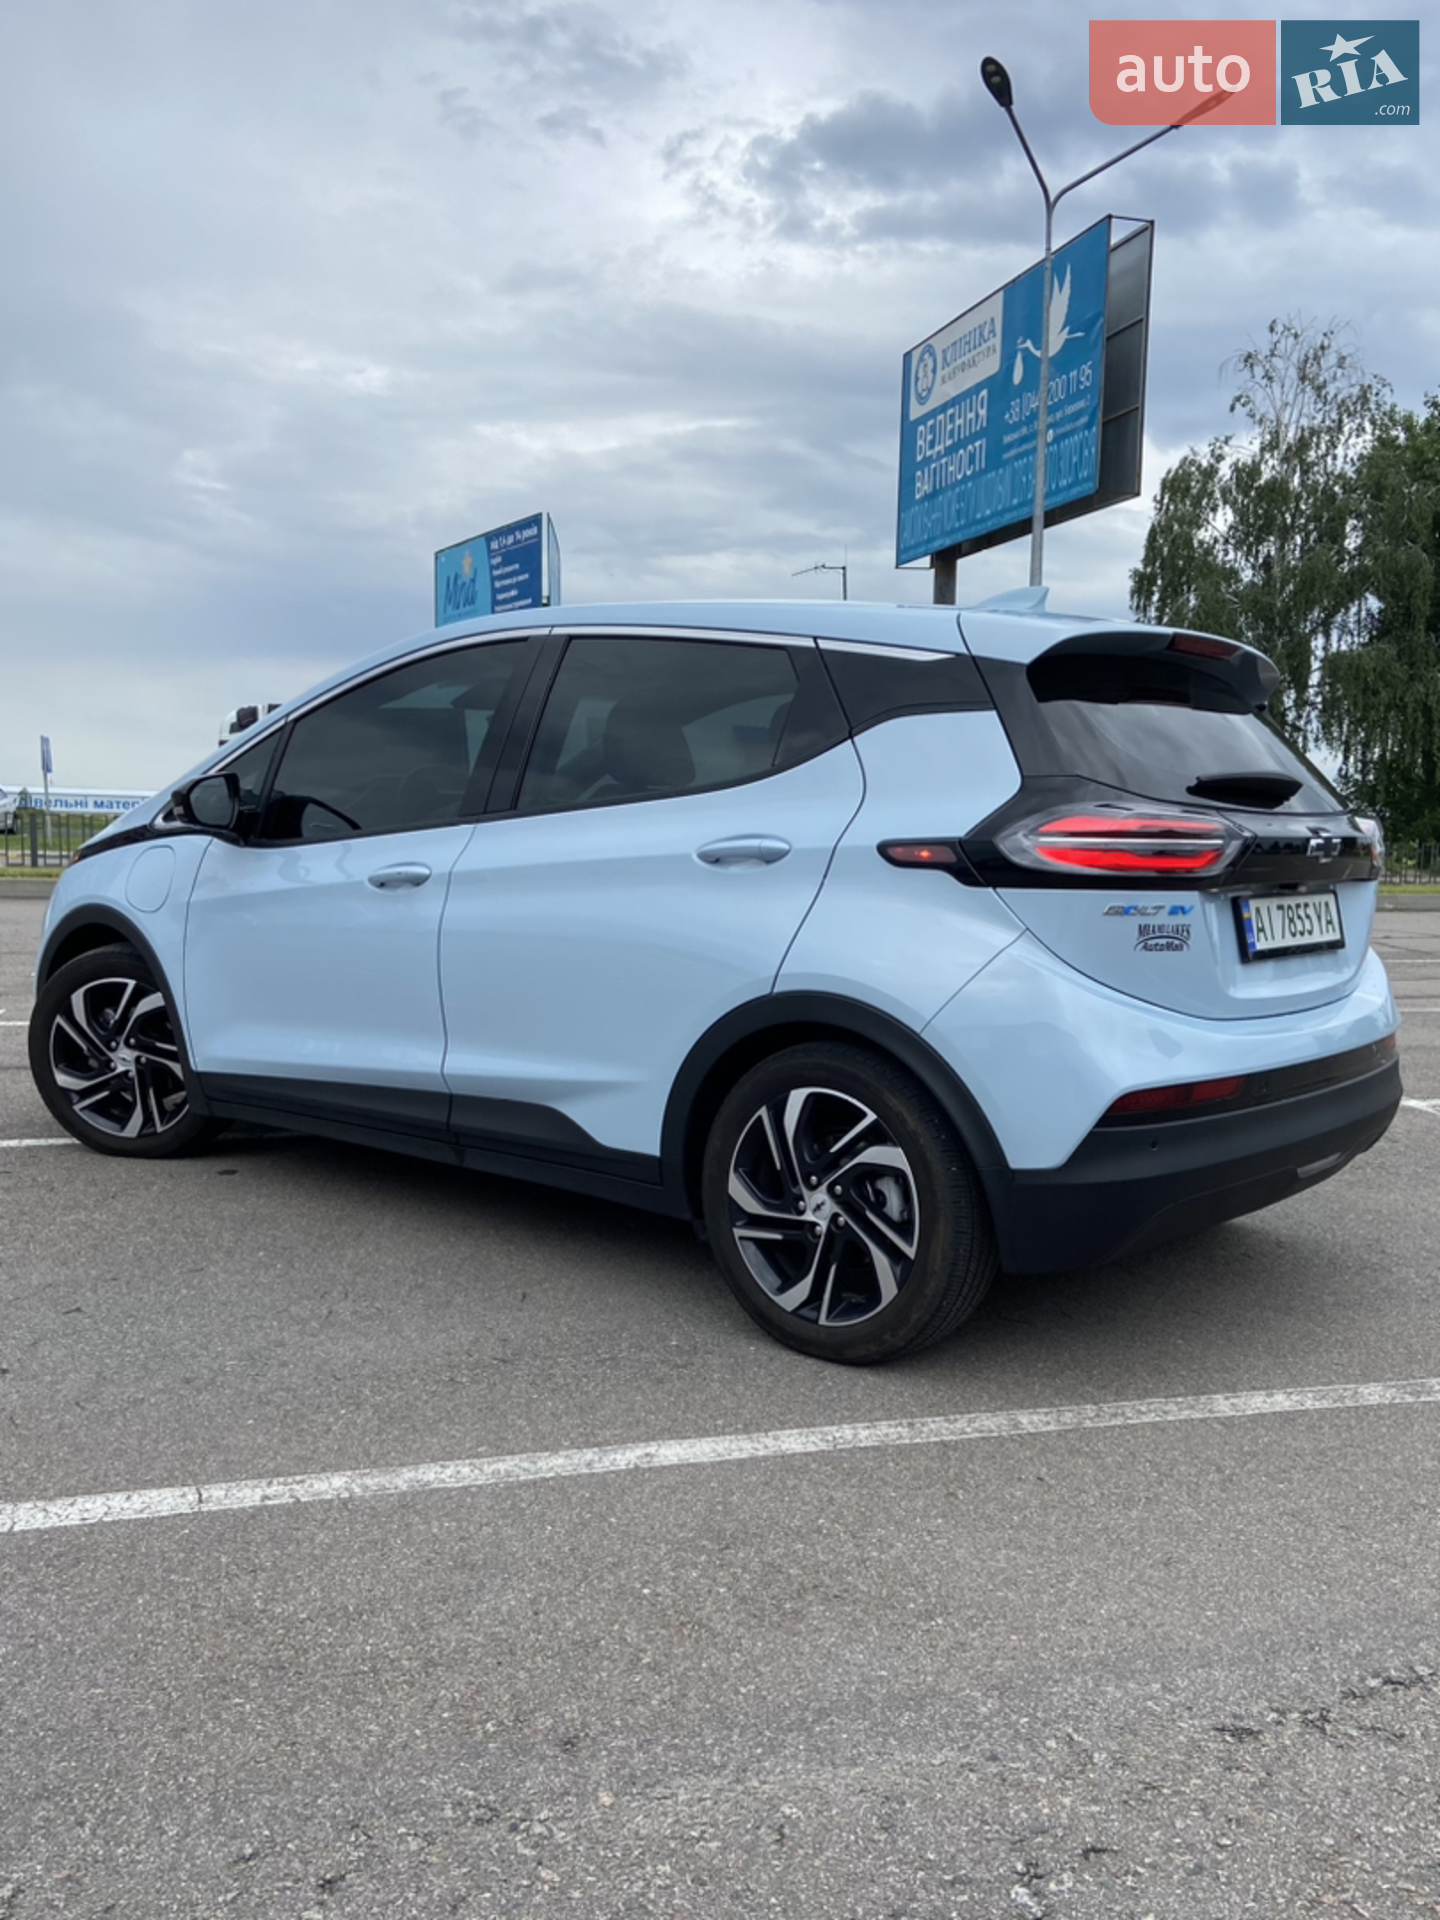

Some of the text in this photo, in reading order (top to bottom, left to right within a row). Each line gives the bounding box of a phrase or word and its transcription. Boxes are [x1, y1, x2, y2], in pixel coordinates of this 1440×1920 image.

[941, 316, 997, 371] КЛІНІКА
[1003, 398, 1021, 425] +38
[1048, 374, 1068, 406] 200
[1069, 368, 1079, 395] 11
[1079, 360, 1093, 391] 95
[916, 388, 989, 463] ВЕДЕННЯ
[914, 437, 987, 500] ВАГІТНОСТІ
[1102, 903, 1195, 917] BOLT EV
